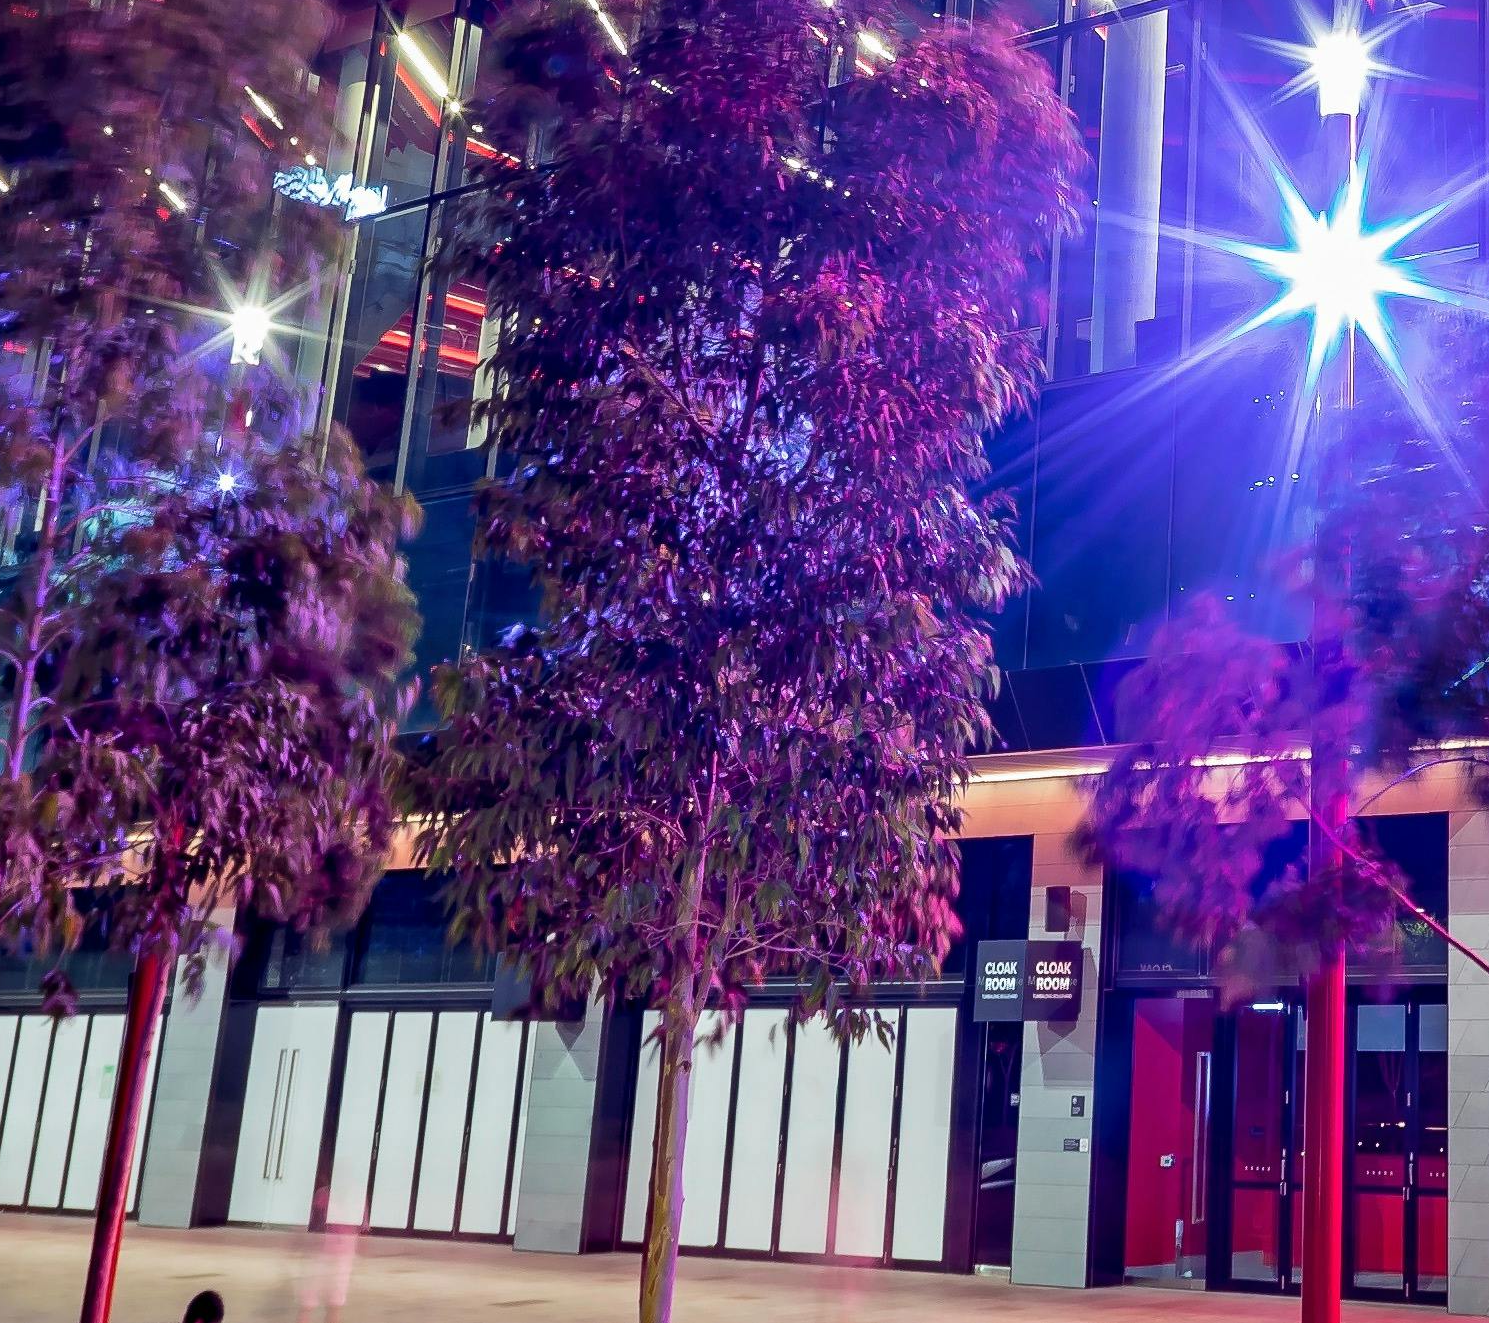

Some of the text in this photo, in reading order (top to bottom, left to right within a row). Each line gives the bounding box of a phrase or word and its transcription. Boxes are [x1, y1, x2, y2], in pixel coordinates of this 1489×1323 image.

[984, 961, 1018, 975] CLOAK
[1035, 961, 1072, 975] CLOAK
[984, 977, 1016, 991] ROOM
[1035, 977, 1070, 991] ROOM
